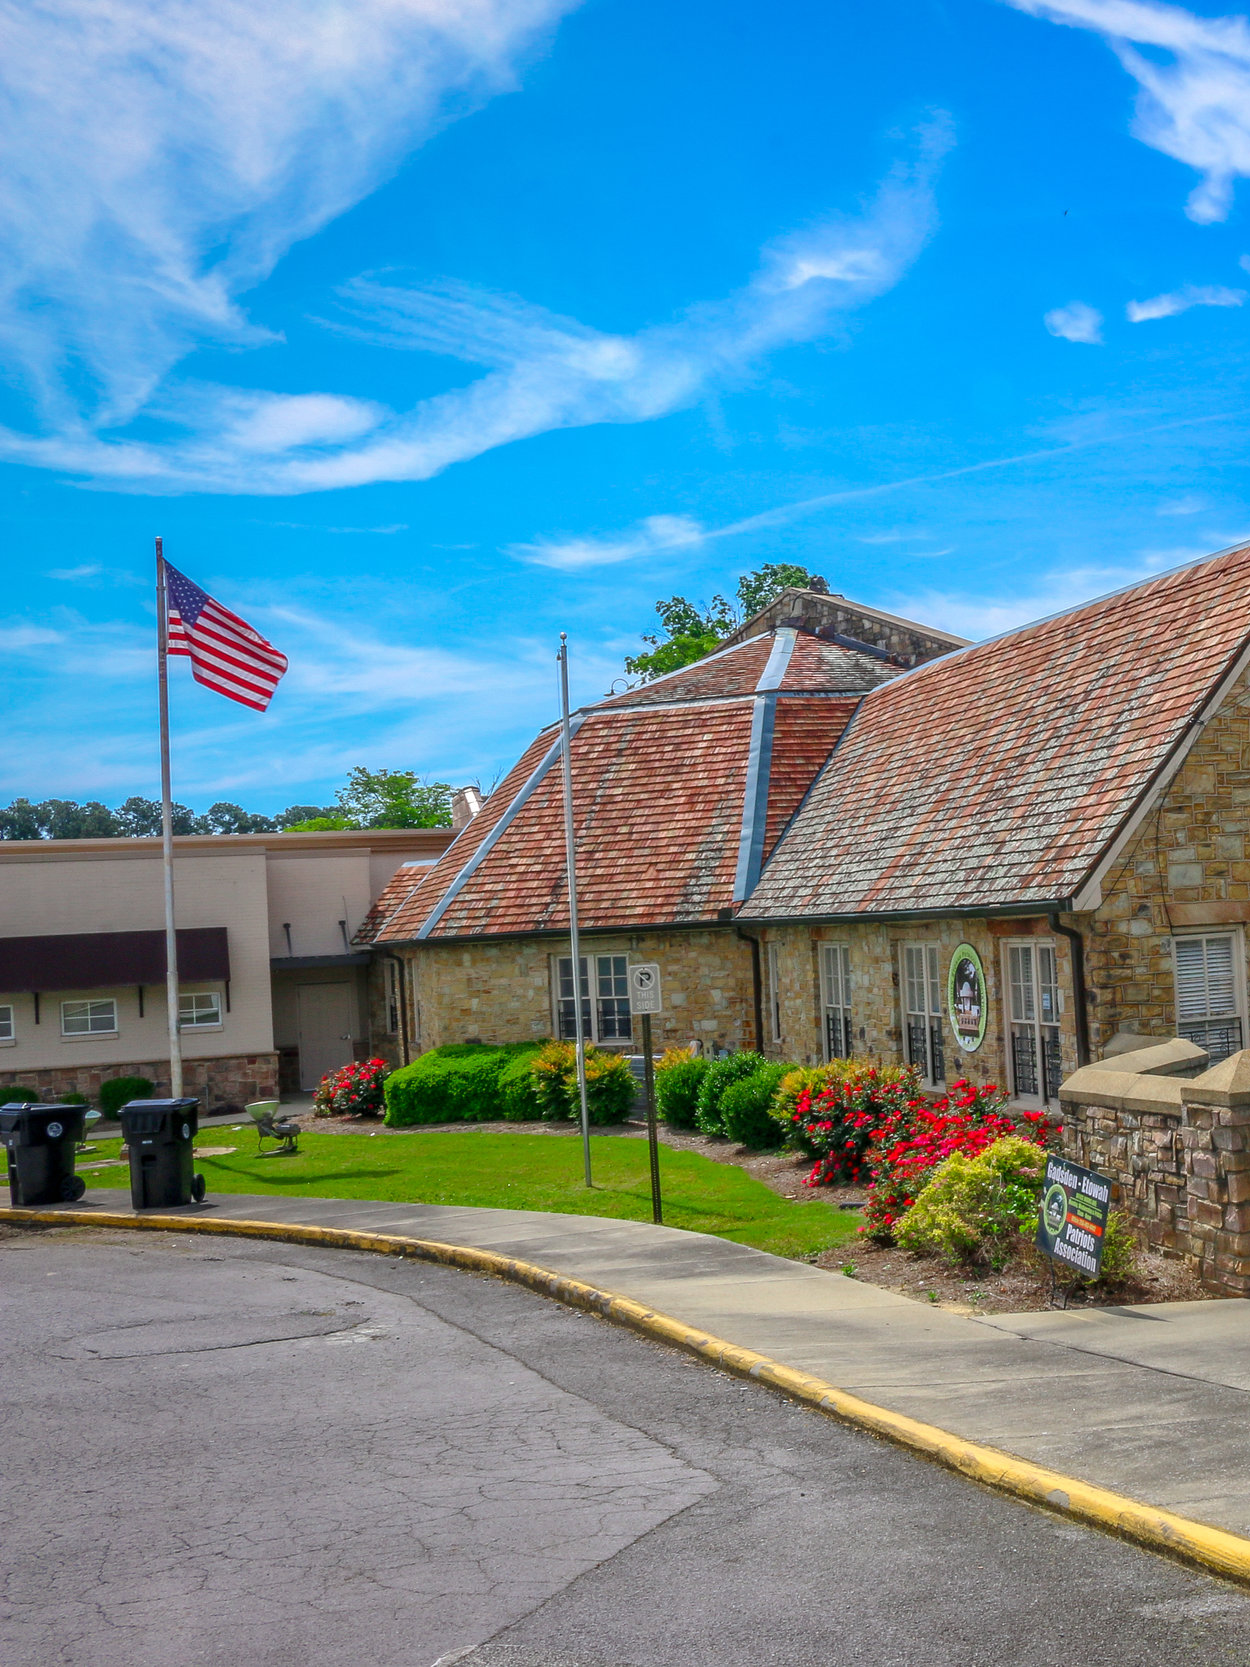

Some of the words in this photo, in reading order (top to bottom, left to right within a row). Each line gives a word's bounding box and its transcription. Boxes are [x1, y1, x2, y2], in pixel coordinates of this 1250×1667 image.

[636, 991, 654, 1000] THIS
[636, 1001, 655, 1010] SIDE
[1047, 1162, 1078, 1190] Gadsden
[1081, 1176, 1108, 1203] Etowah
[1065, 1223, 1095, 1252] Patriots
[1053, 1237, 1097, 1273] Association
